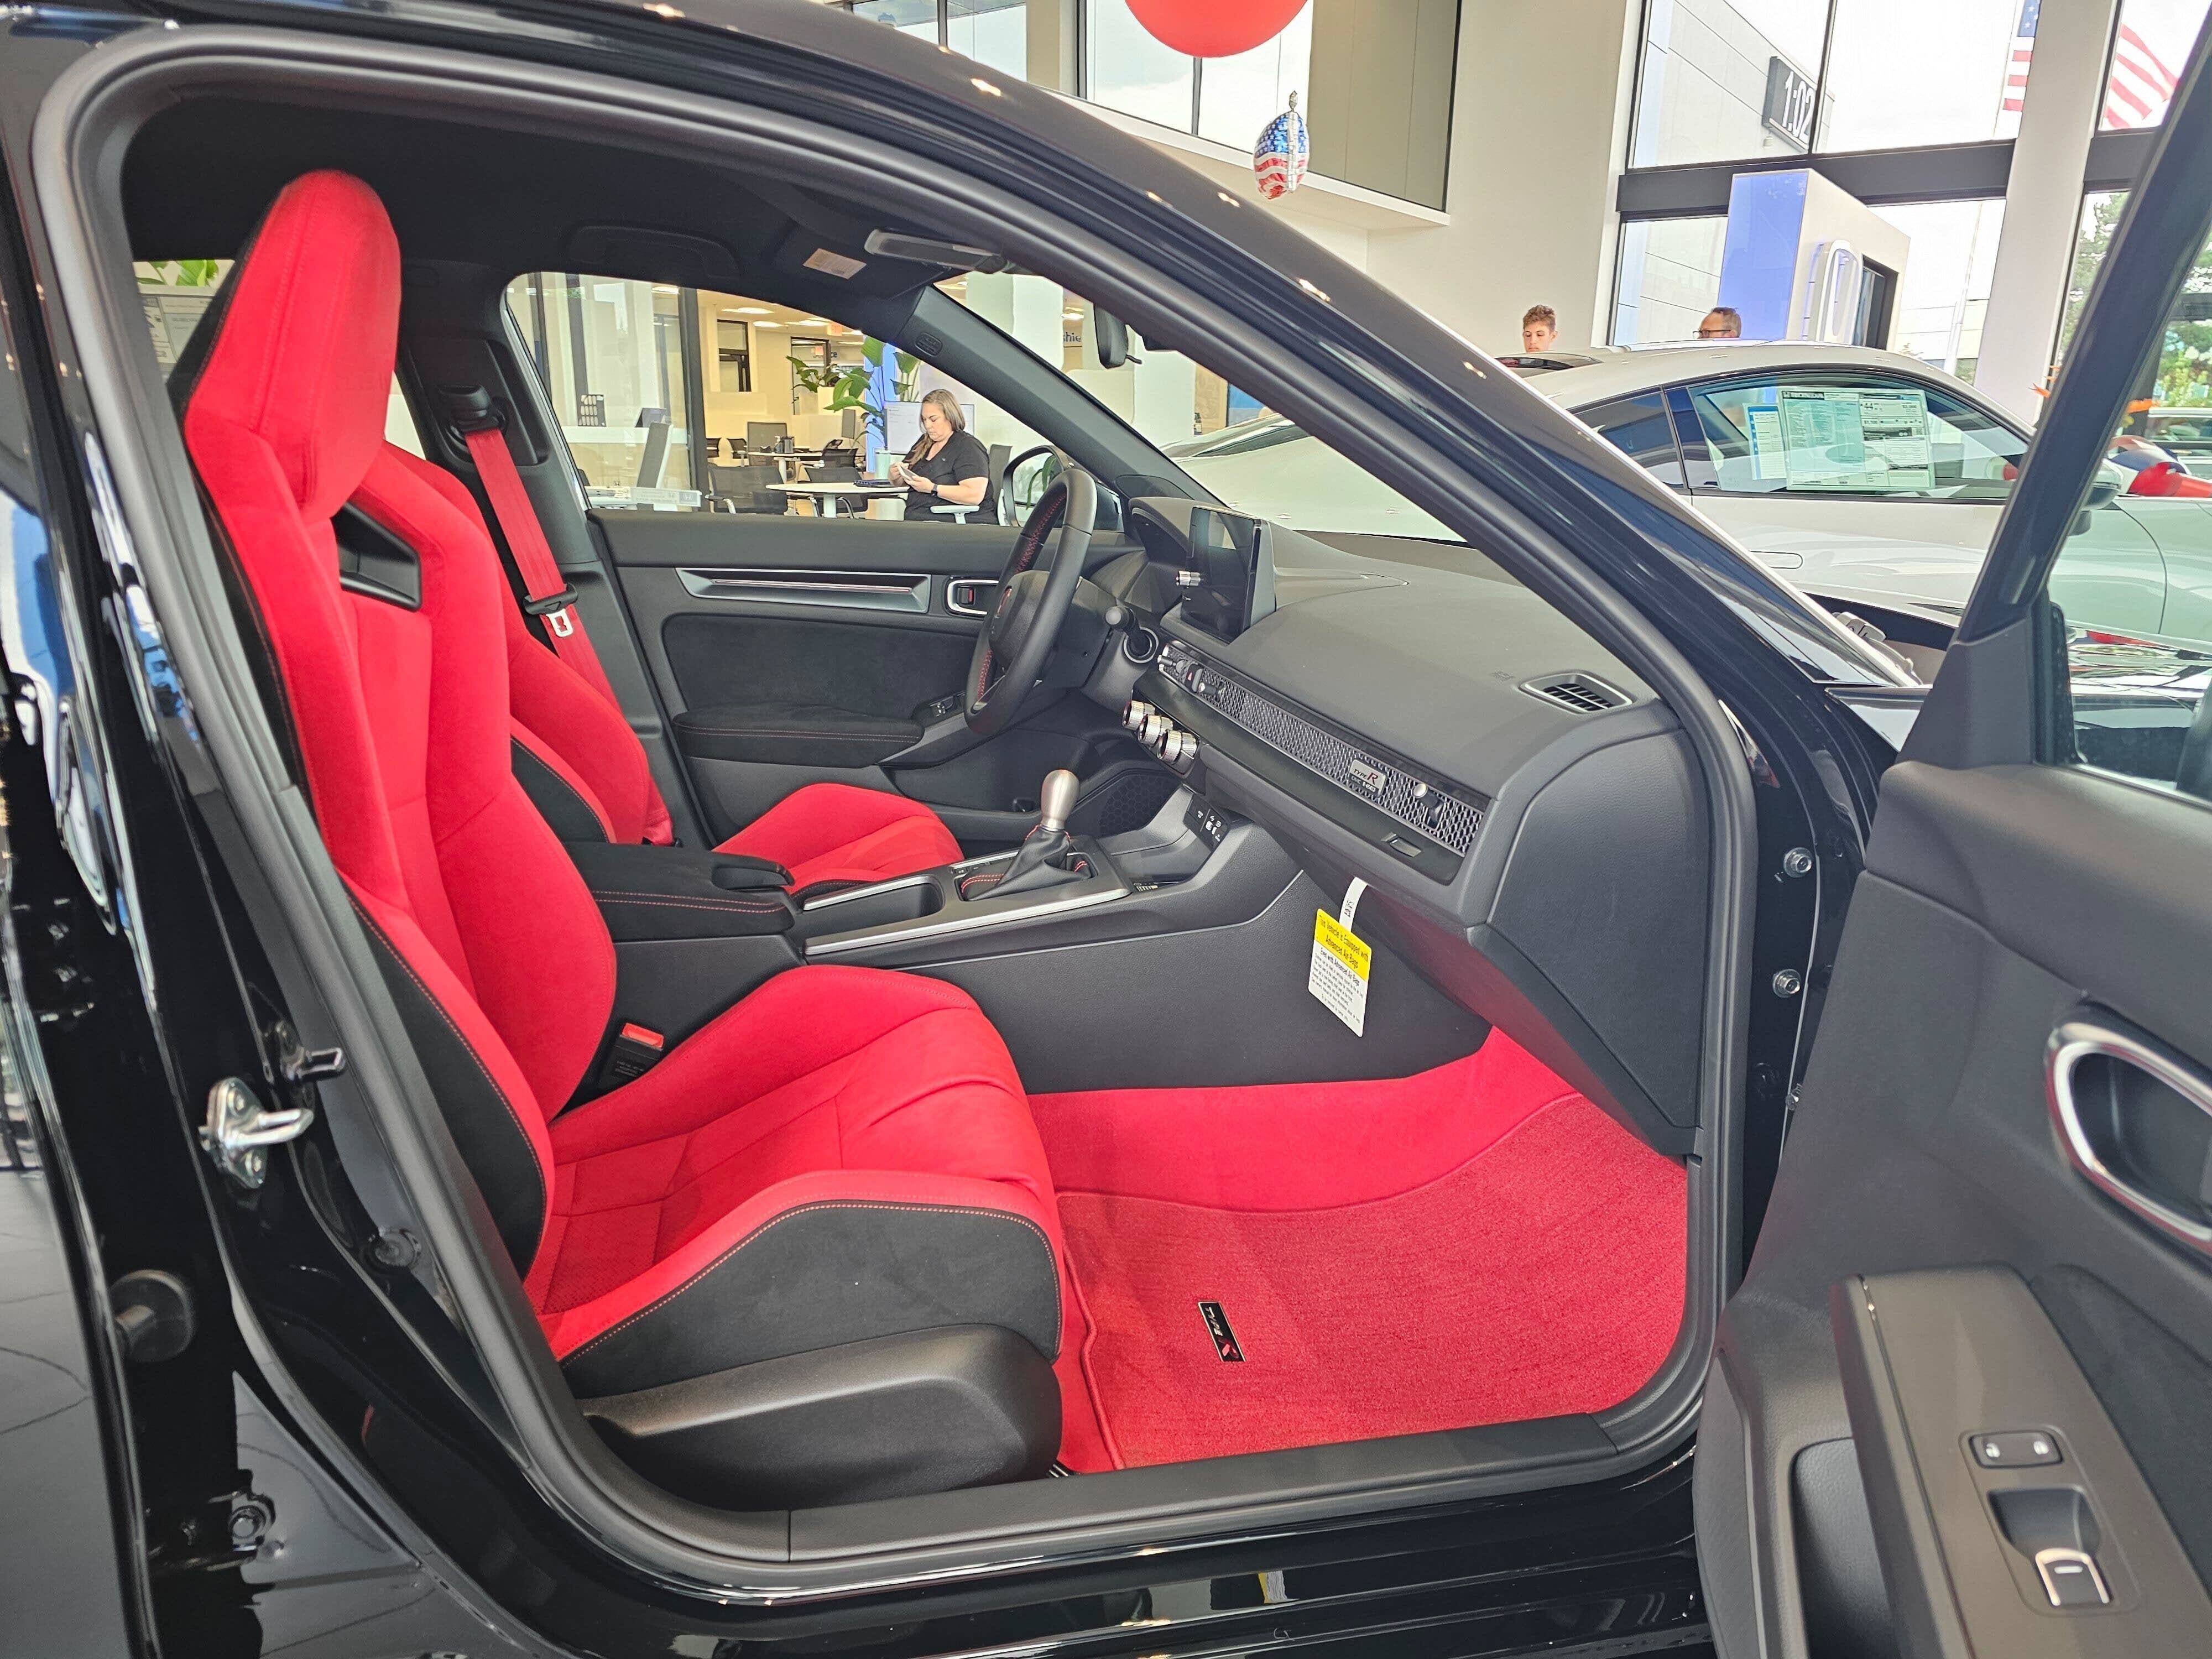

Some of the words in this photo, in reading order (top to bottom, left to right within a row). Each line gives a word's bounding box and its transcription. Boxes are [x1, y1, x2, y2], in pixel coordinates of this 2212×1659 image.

[1783, 71, 1814, 140] 1:02
[1354, 769, 1367, 779] TYPE
[1367, 772, 1379, 785] R
